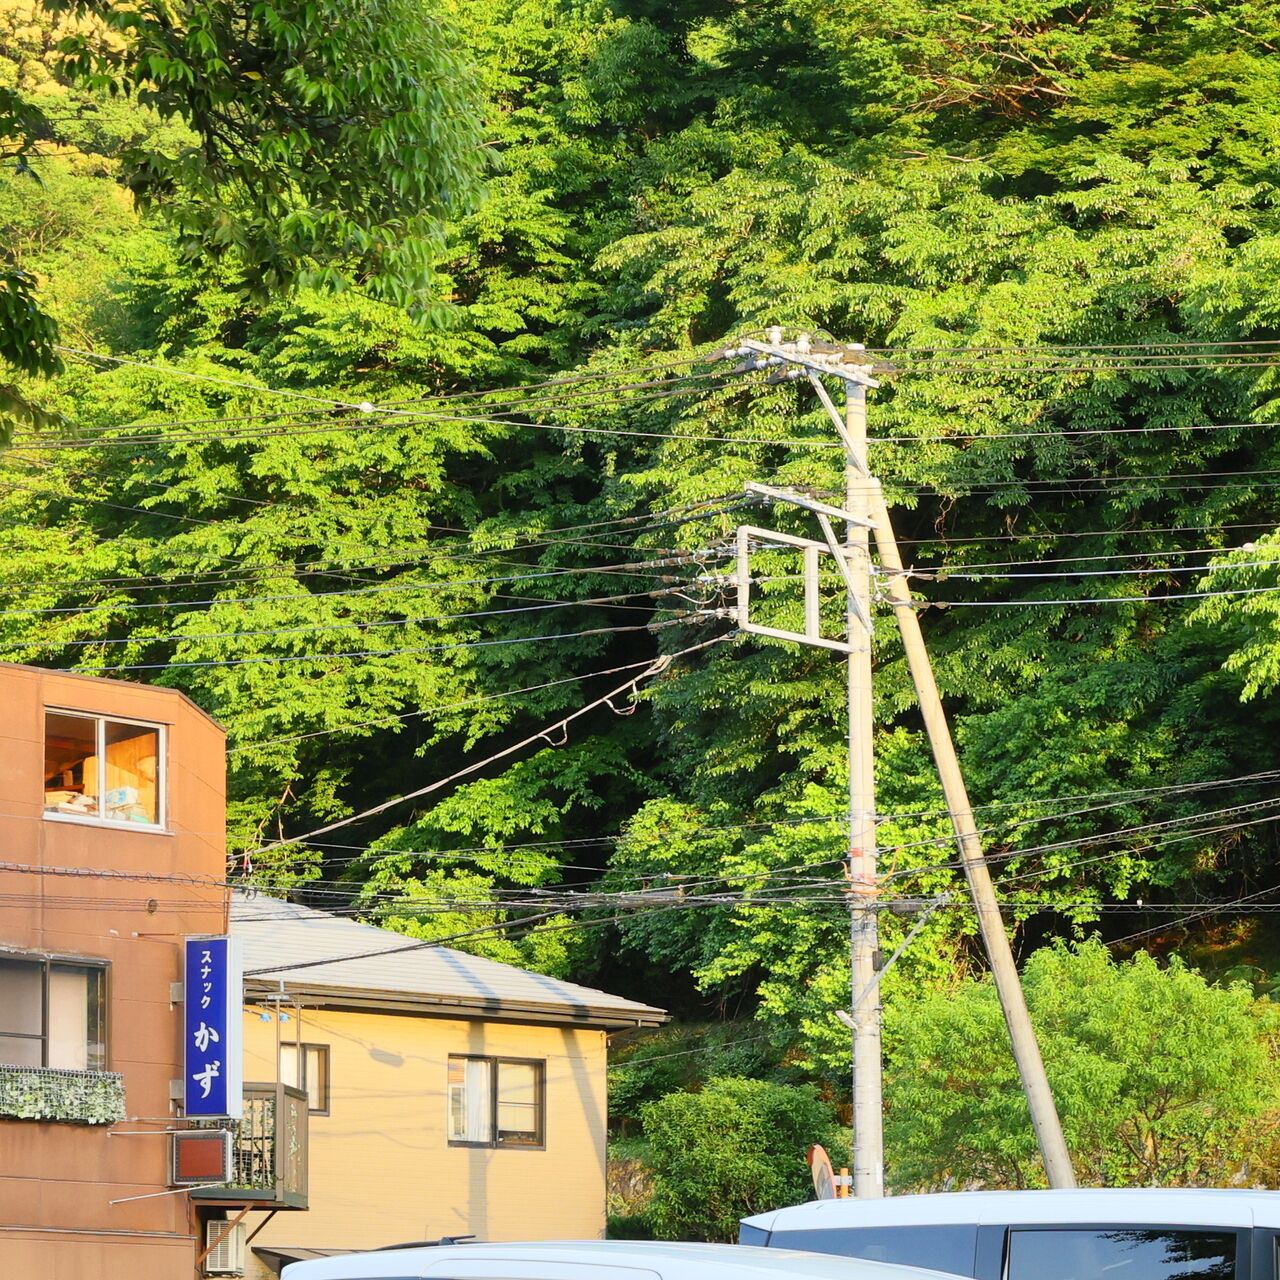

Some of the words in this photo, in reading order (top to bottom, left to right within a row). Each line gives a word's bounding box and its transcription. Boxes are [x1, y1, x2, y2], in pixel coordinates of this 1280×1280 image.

[200, 951, 212, 1009] スナック
[192, 1021, 221, 1099] かず
